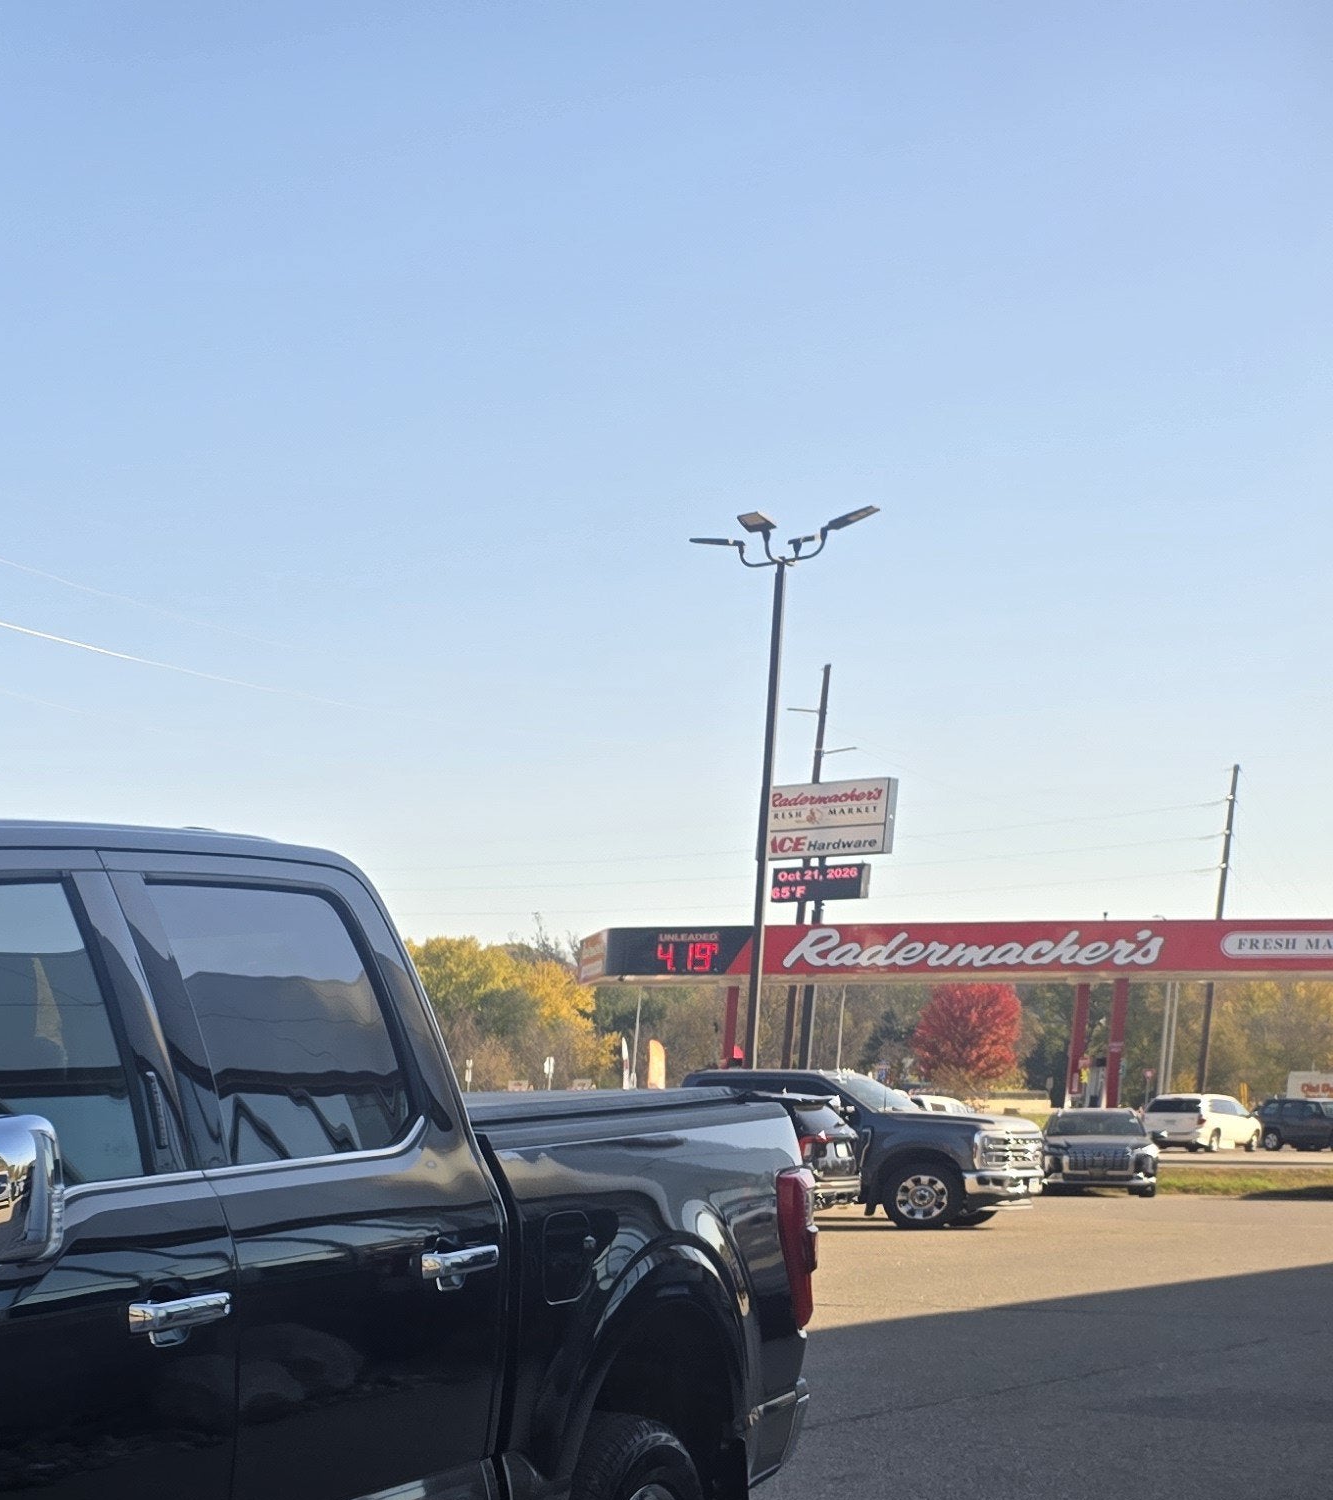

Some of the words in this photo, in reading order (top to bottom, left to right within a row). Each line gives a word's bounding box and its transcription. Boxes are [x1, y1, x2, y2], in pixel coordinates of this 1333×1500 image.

[828, 805, 877, 815] MARKET
[807, 838, 878, 852] Hardware
[778, 871, 801, 882] Oct
[804, 869, 823, 880] 21,
[783, 928, 1164, 968] Radermacher's
[1237, 938, 1297, 950] FRESH
